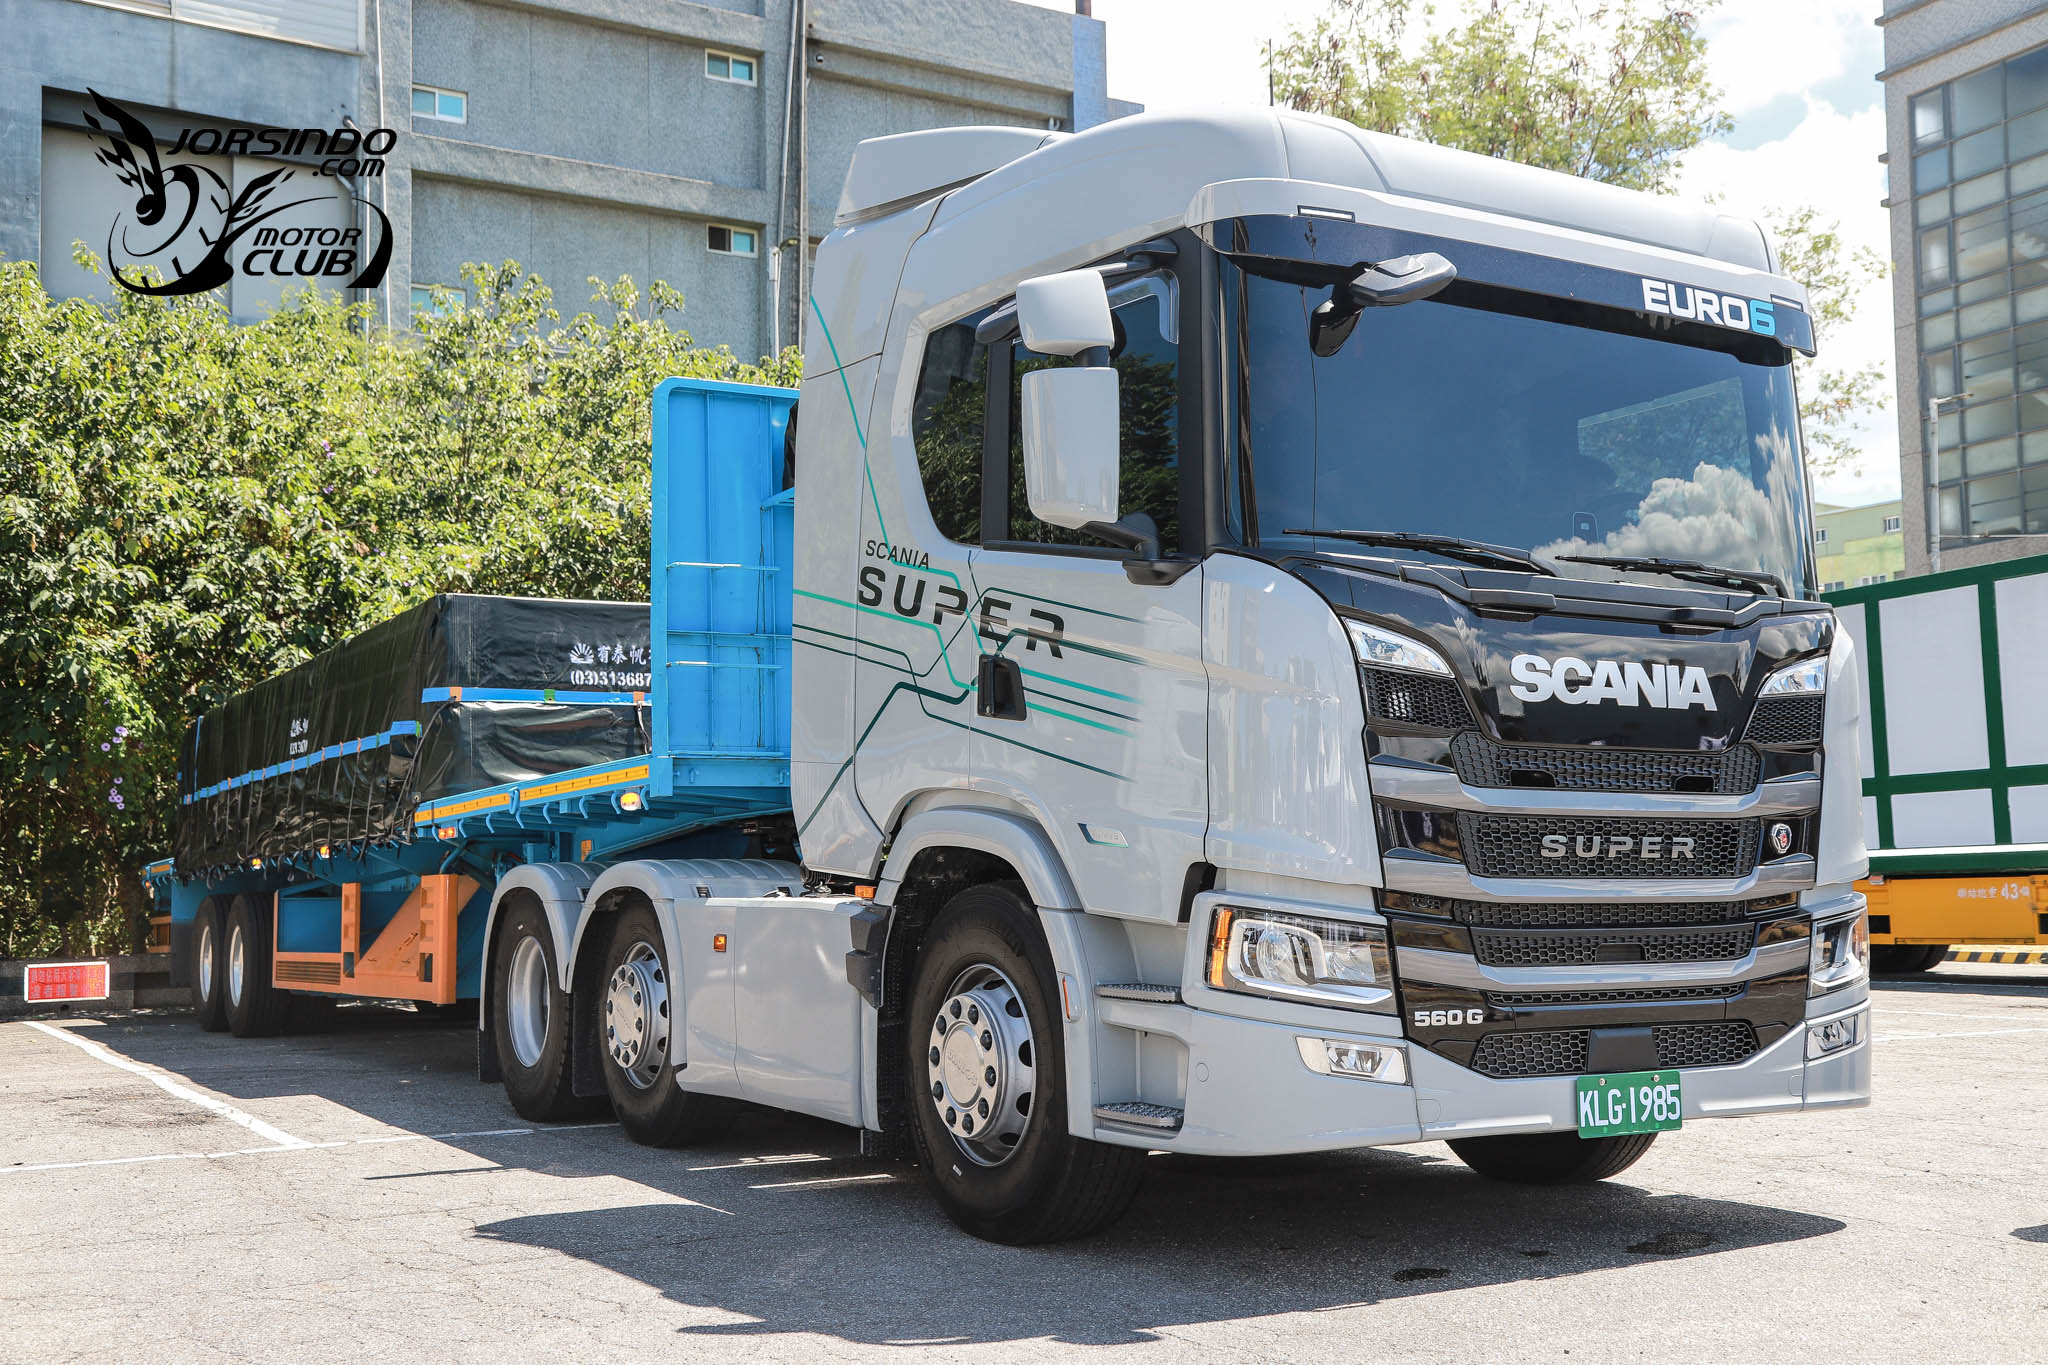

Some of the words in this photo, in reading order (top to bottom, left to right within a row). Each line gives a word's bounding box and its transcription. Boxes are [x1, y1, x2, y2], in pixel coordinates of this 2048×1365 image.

[1641, 278, 1776, 336] EURO6
[865, 540, 930, 570] SCANIA
[858, 566, 1065, 660] SUPER
[597, 643, 651, 665] 有泰帆
[1509, 653, 1718, 712] SCANIA
[1540, 834, 1697, 859] SUPER
[1414, 1010, 1462, 1027] 560
